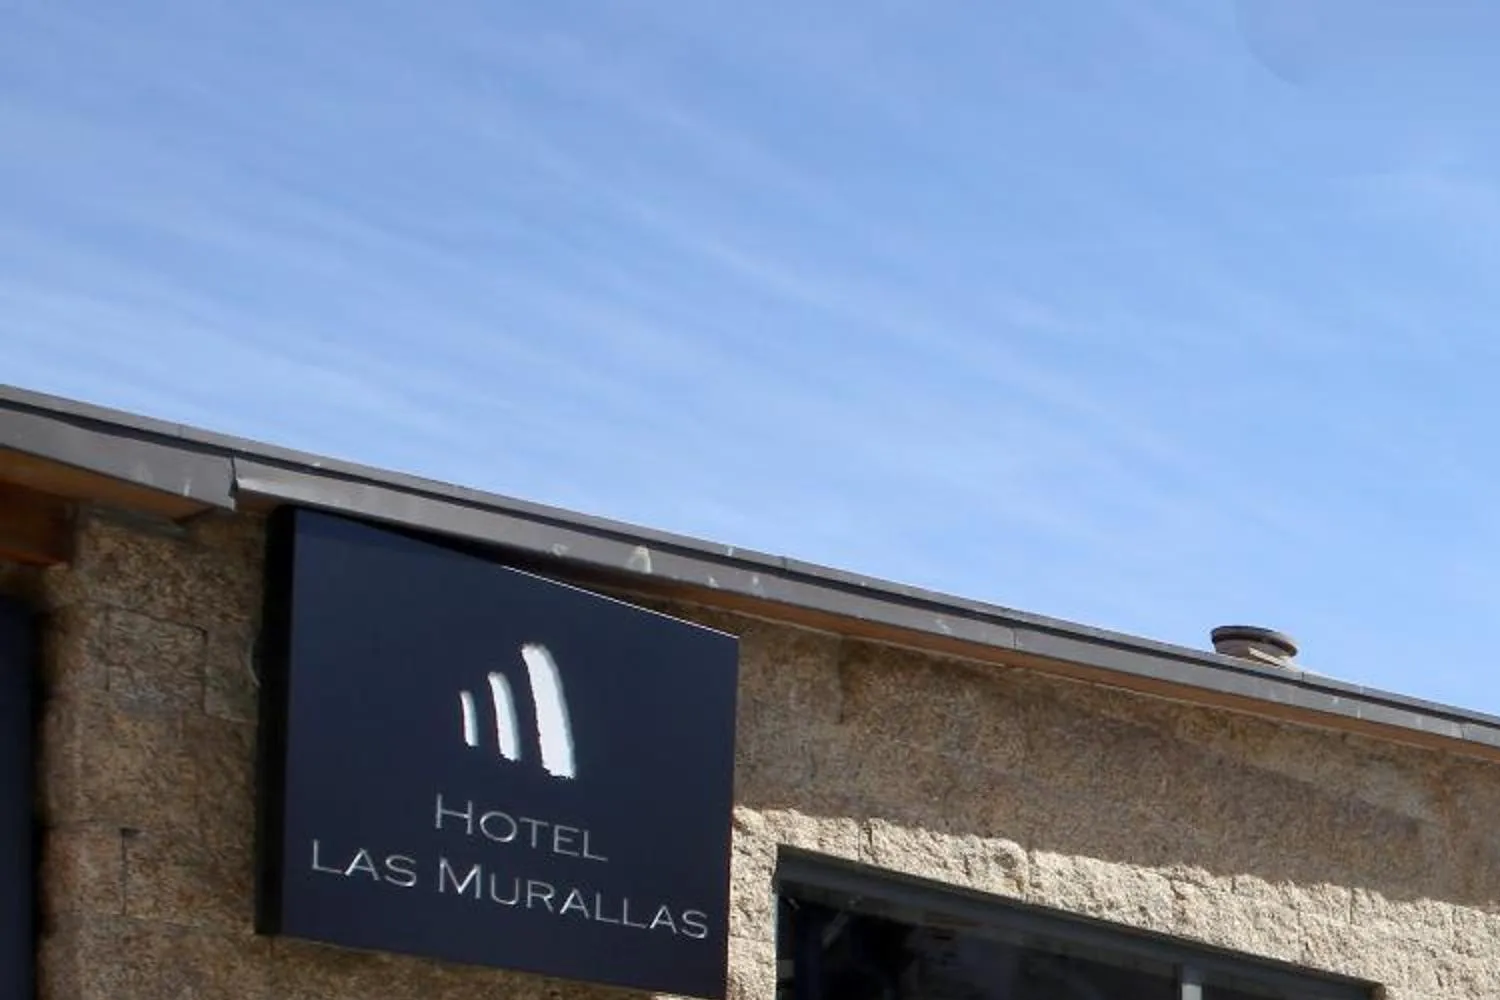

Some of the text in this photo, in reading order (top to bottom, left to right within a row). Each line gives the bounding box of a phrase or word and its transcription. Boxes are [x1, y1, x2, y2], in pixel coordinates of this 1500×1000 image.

[435, 794, 608, 862] HOTEL
[312, 839, 709, 939] LAS MURALLAS
